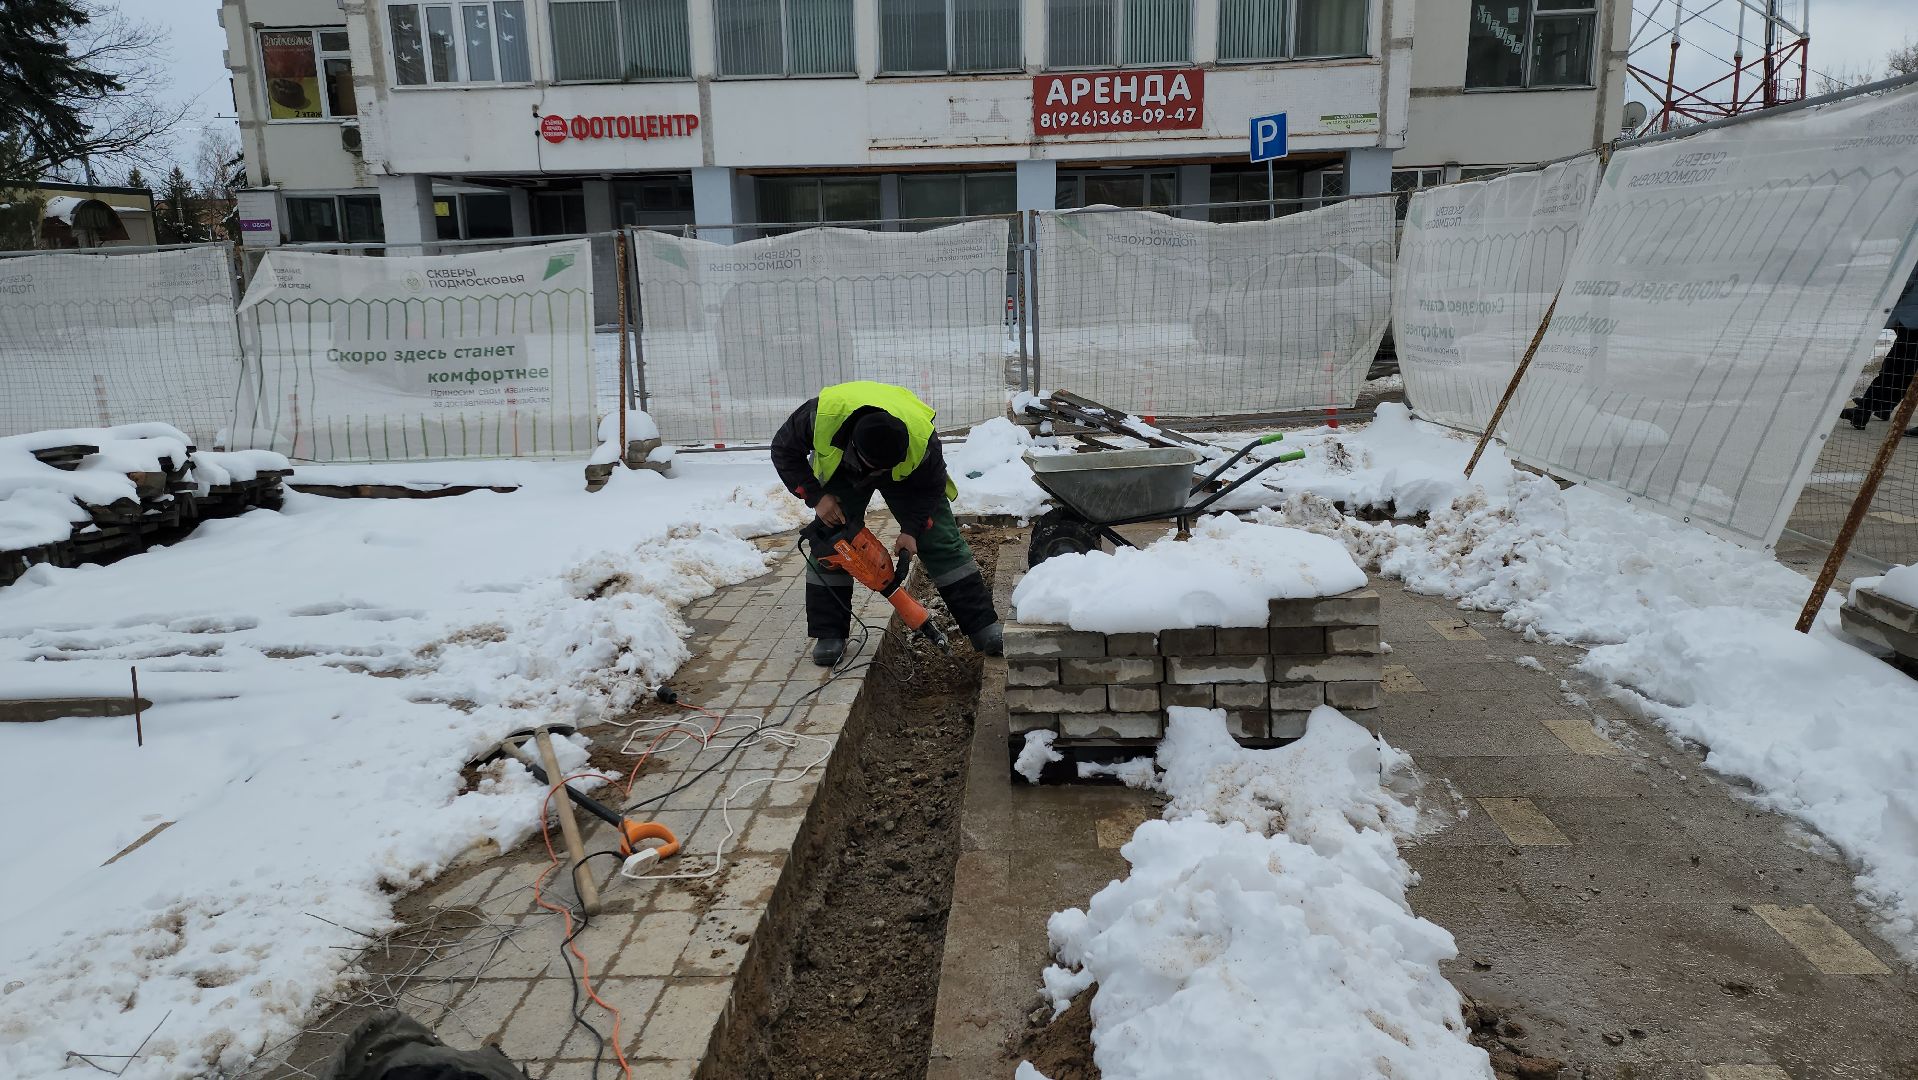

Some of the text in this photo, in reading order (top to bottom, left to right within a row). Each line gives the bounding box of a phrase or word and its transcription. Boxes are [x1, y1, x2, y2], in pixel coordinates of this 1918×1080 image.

[1045, 73, 1192, 107] АРЕНДА
[570, 114, 699, 141] ФОТОЦЕНТР
[1040, 107, 1197, 129] 8(926)368-09-47
[1257, 119, 1278, 156] P
[426, 268, 477, 280] СКВЕРЫ
[429, 274, 525, 289] ПОДМОСКОВЬЯ
[326, 344, 515, 364] Скоро здесь станет
[427, 366, 549, 385] комфортнее
